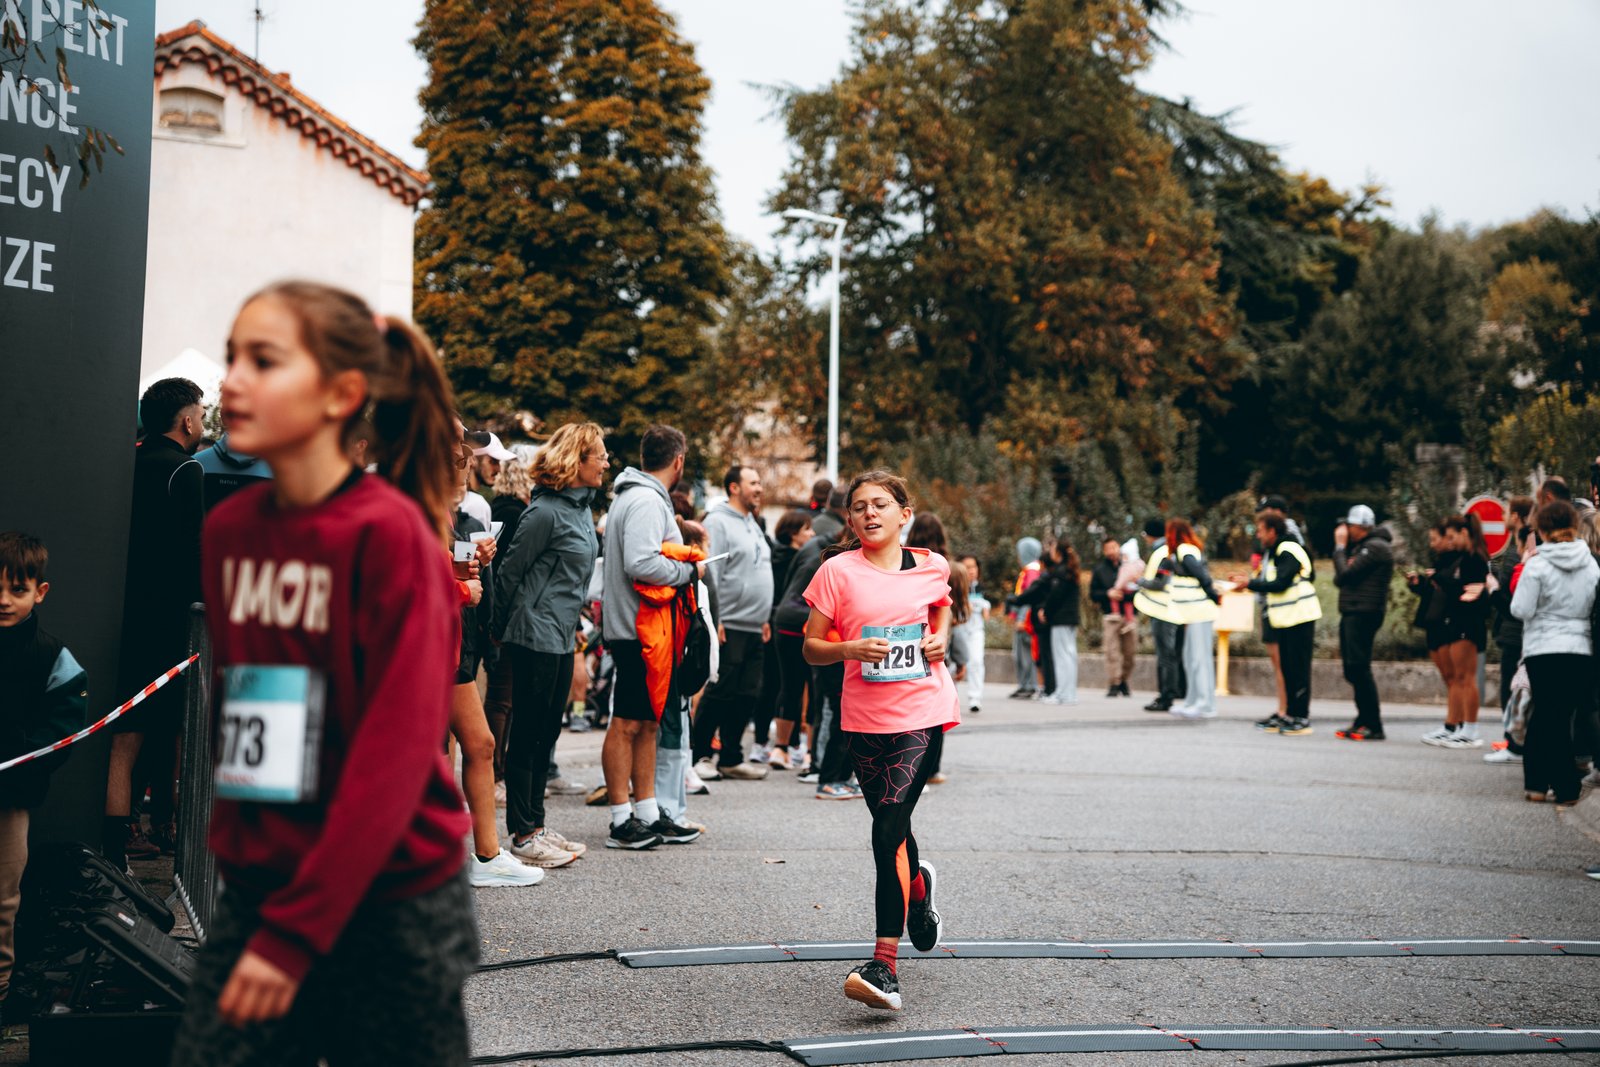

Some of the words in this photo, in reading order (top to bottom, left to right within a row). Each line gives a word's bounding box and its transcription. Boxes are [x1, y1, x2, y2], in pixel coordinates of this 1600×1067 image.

[0, 70, 80, 135] NCE
[0, 153, 71, 213] ECY
[0, 236, 55, 292] ZE
[219, 714, 265, 768] 73
